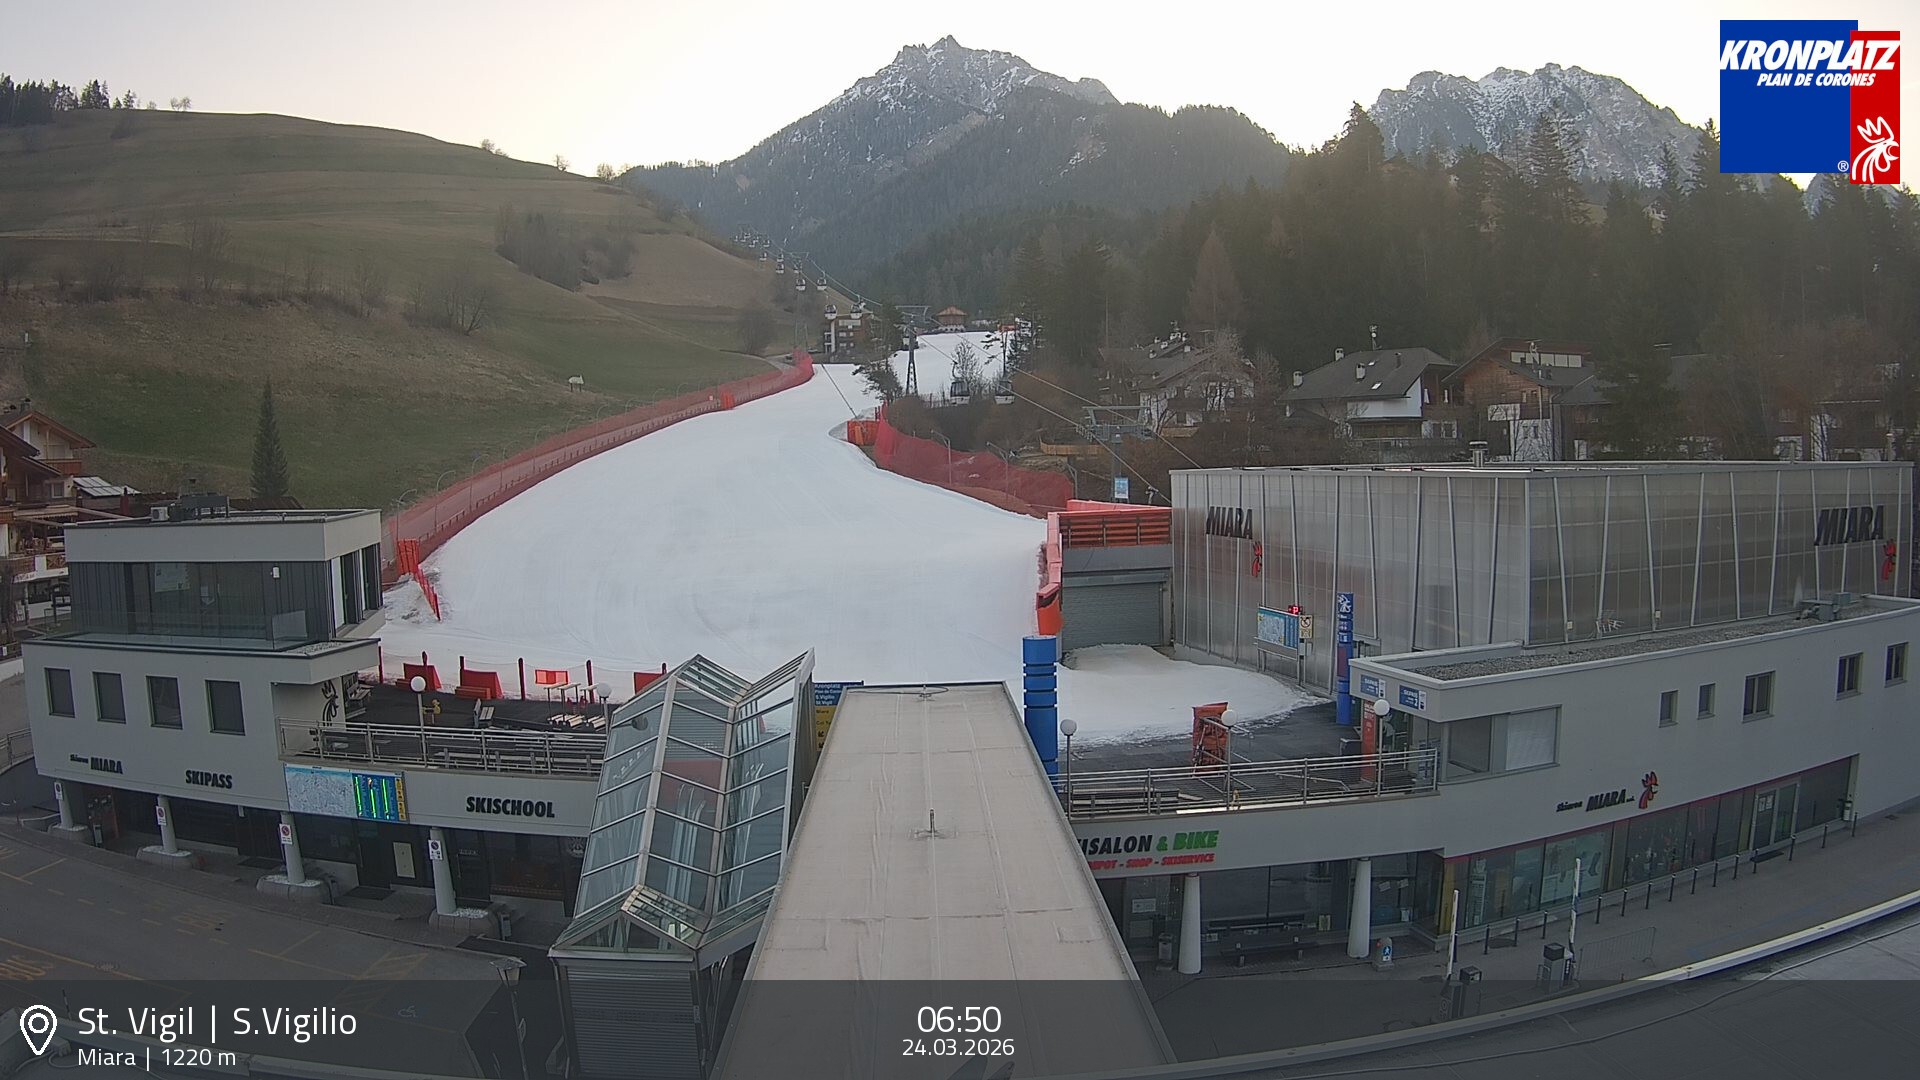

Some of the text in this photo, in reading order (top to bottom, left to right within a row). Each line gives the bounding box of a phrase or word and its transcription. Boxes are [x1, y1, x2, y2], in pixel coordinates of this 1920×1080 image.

[1206, 506, 1253, 539] MIARA
[1814, 505, 1884, 547] MIARA
[90, 757, 123, 774] MIARA
[185, 770, 233, 789] SKIPASS
[466, 796, 555, 818] SKISCHOOL
[1586, 789, 1626, 812] MIARA
[1156, 836, 1168, 852] &
[1173, 830, 1219, 850] BIKE
